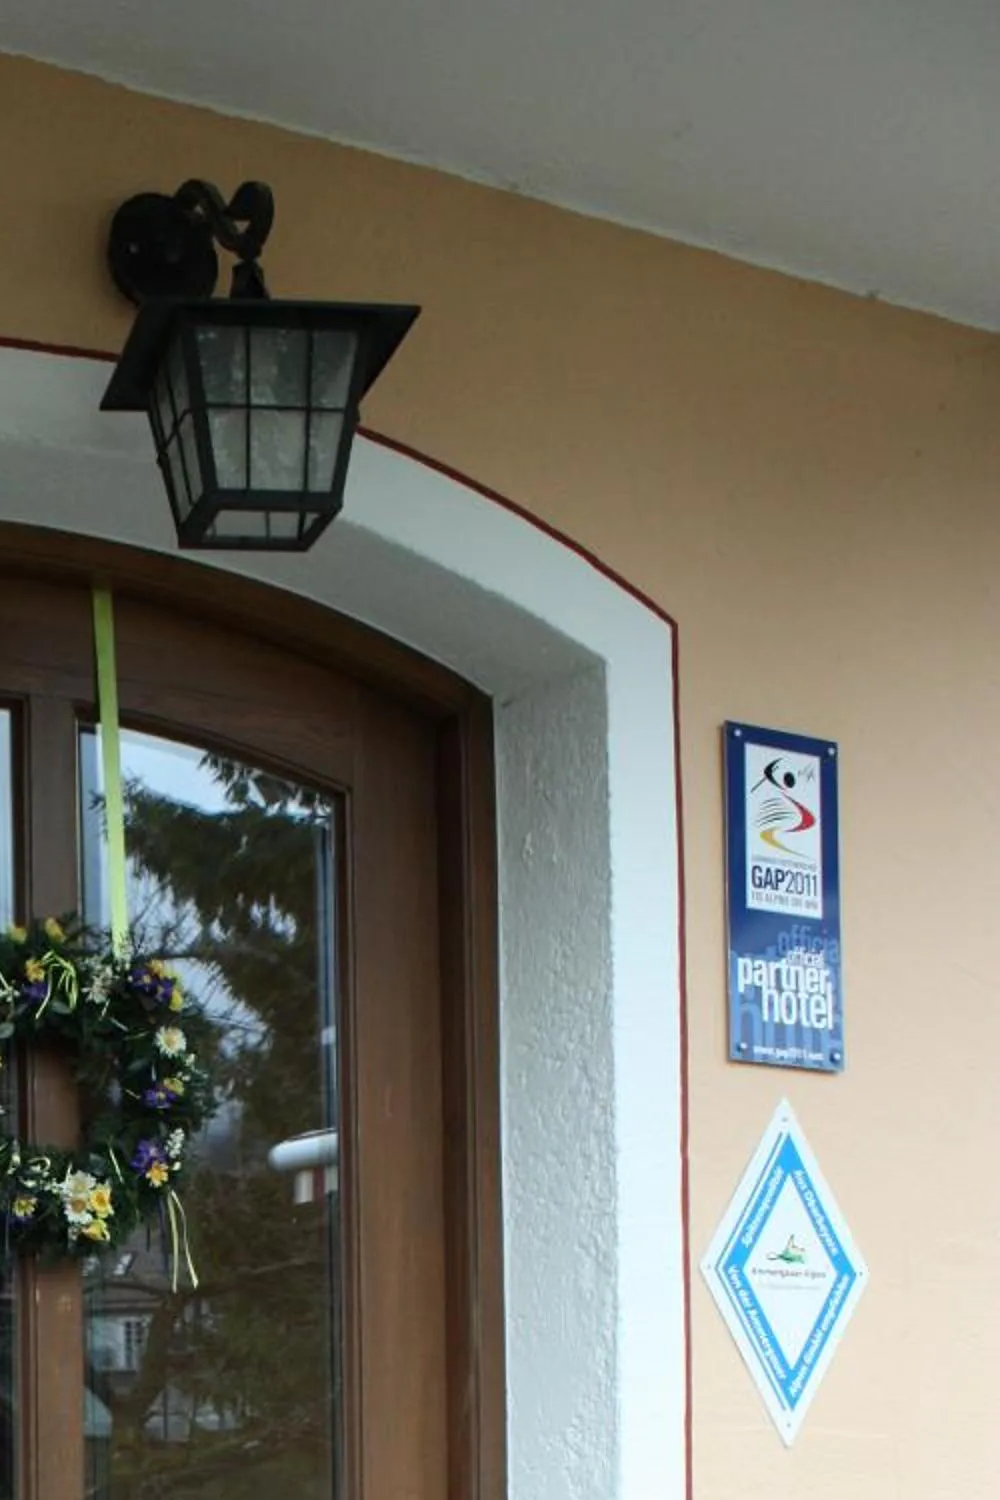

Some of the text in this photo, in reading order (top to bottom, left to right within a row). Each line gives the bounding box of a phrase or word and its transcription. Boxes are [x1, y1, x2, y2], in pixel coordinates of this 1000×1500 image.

[752, 865, 817, 896] GAP2011
[737, 957, 830, 993] partner
[762, 982, 833, 1030] hotel
